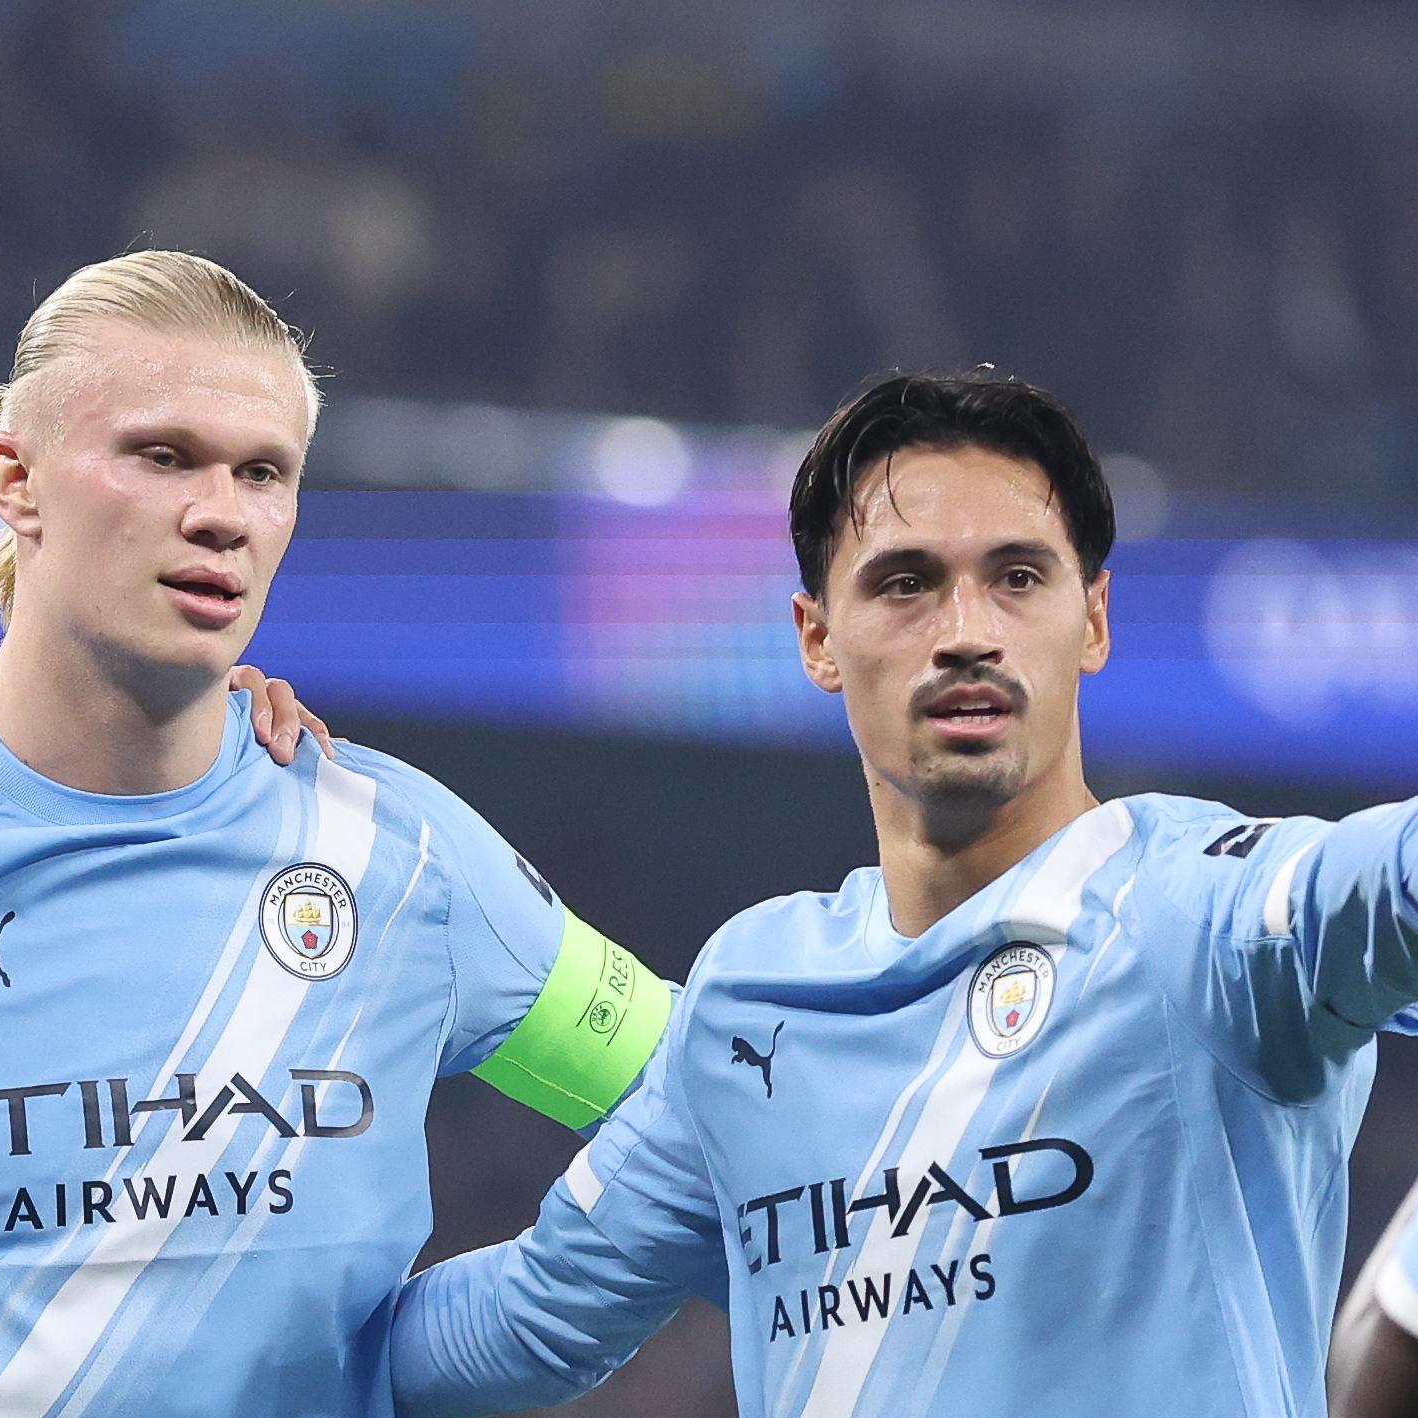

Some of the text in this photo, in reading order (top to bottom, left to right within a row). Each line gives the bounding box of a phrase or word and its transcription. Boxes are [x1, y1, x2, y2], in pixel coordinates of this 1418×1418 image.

[270, 872, 347, 909] MANCHESTER
[300, 962, 327, 972] CITY
[978, 950, 1049, 993] MANCHESTER
[996, 1038, 1022, 1051] CITY
[4, 1169, 295, 1232] AIRWAYS
[770, 1253, 997, 1343] AIRWAYS
